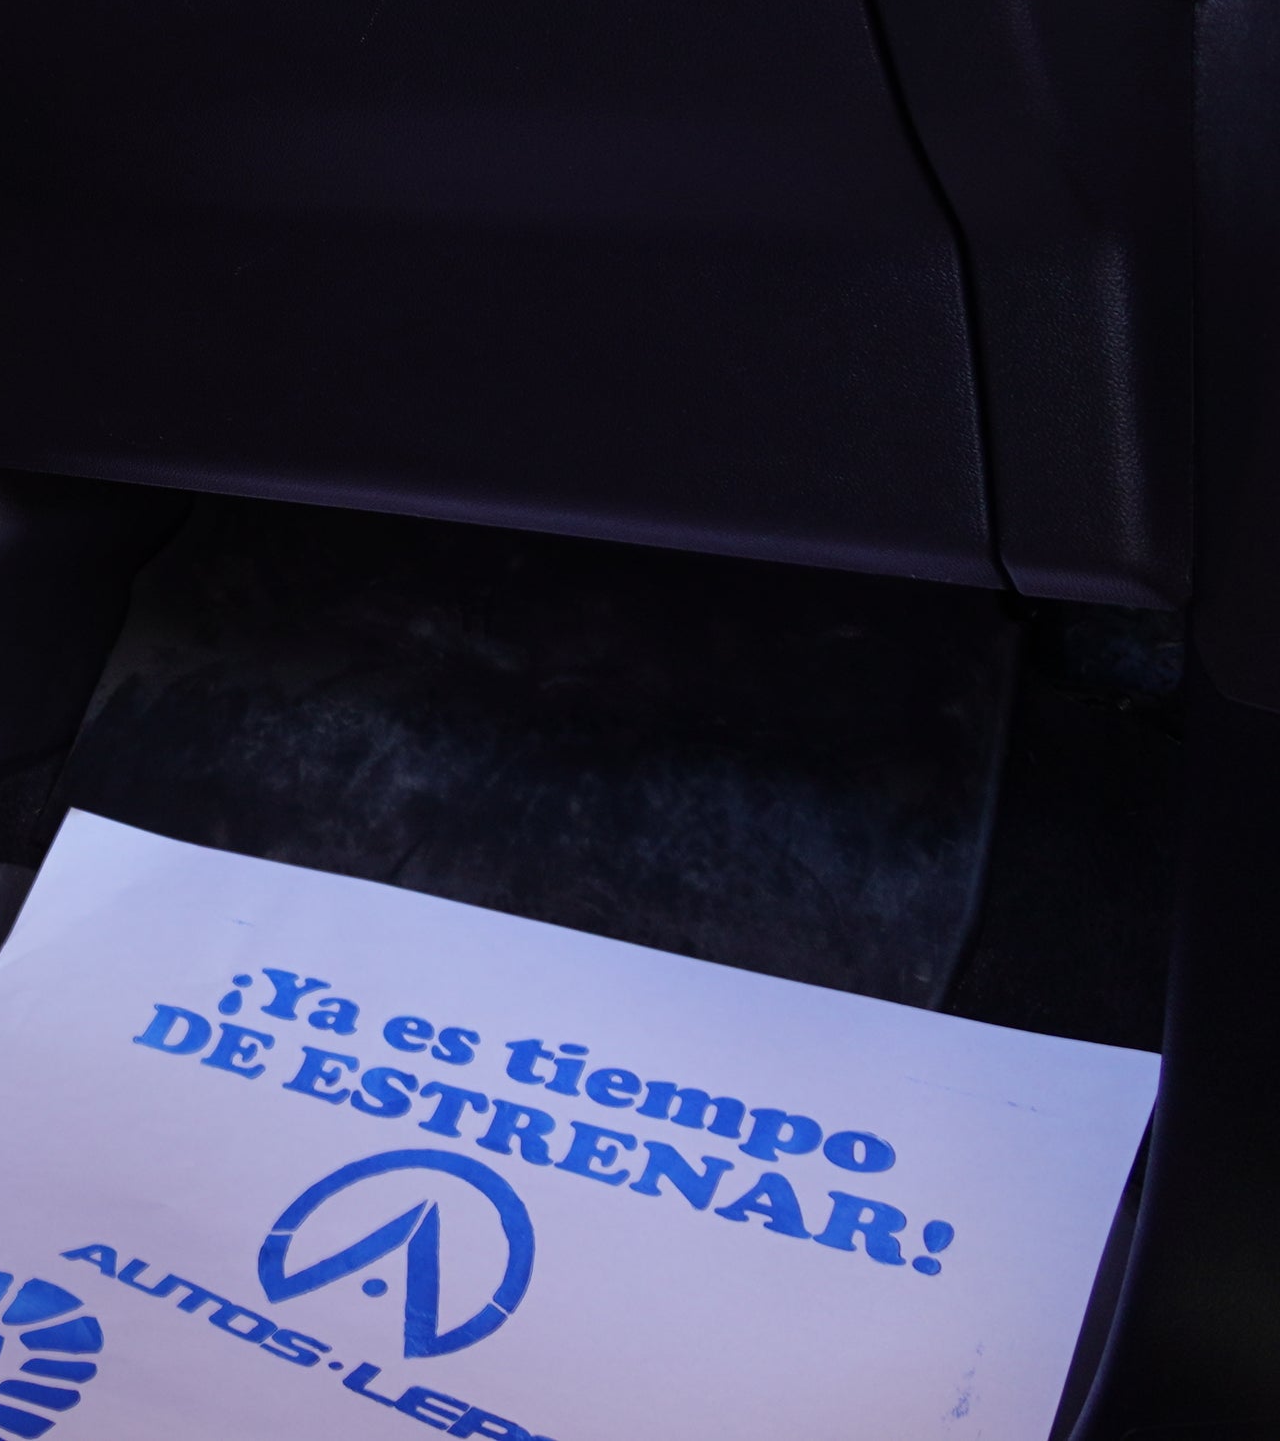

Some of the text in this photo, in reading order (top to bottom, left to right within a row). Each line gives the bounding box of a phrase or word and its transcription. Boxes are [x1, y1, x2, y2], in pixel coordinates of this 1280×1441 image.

[132, 1002, 955, 1277] DE ESTRENAR!
[217, 967, 897, 1174] ¡Ya es tiempo
